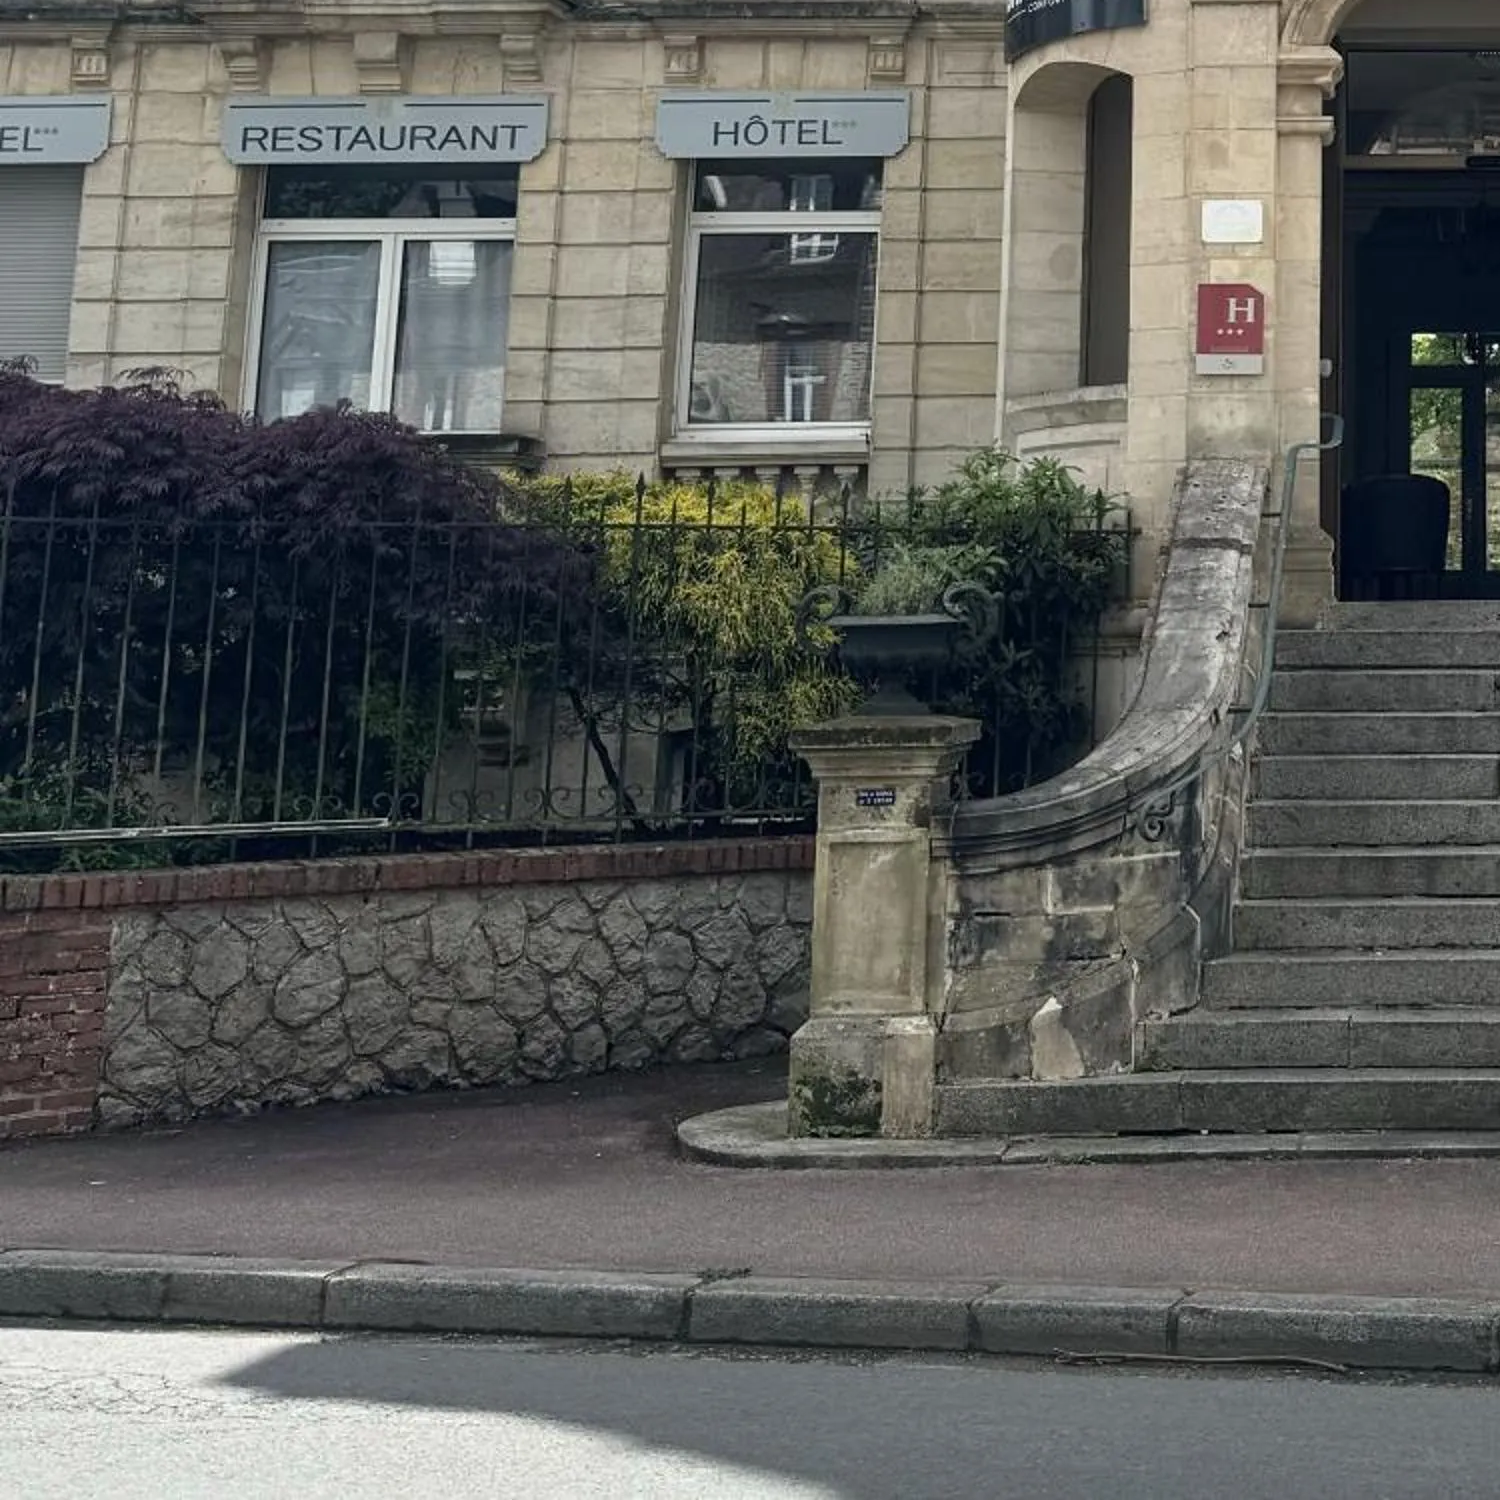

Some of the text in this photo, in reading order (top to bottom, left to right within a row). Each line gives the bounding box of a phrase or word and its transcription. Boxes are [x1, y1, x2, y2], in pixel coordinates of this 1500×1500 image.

[240, 124, 529, 153] RESTAURANT
[712, 114, 844, 147] HÔTEL
[1226, 296, 1257, 323] H
